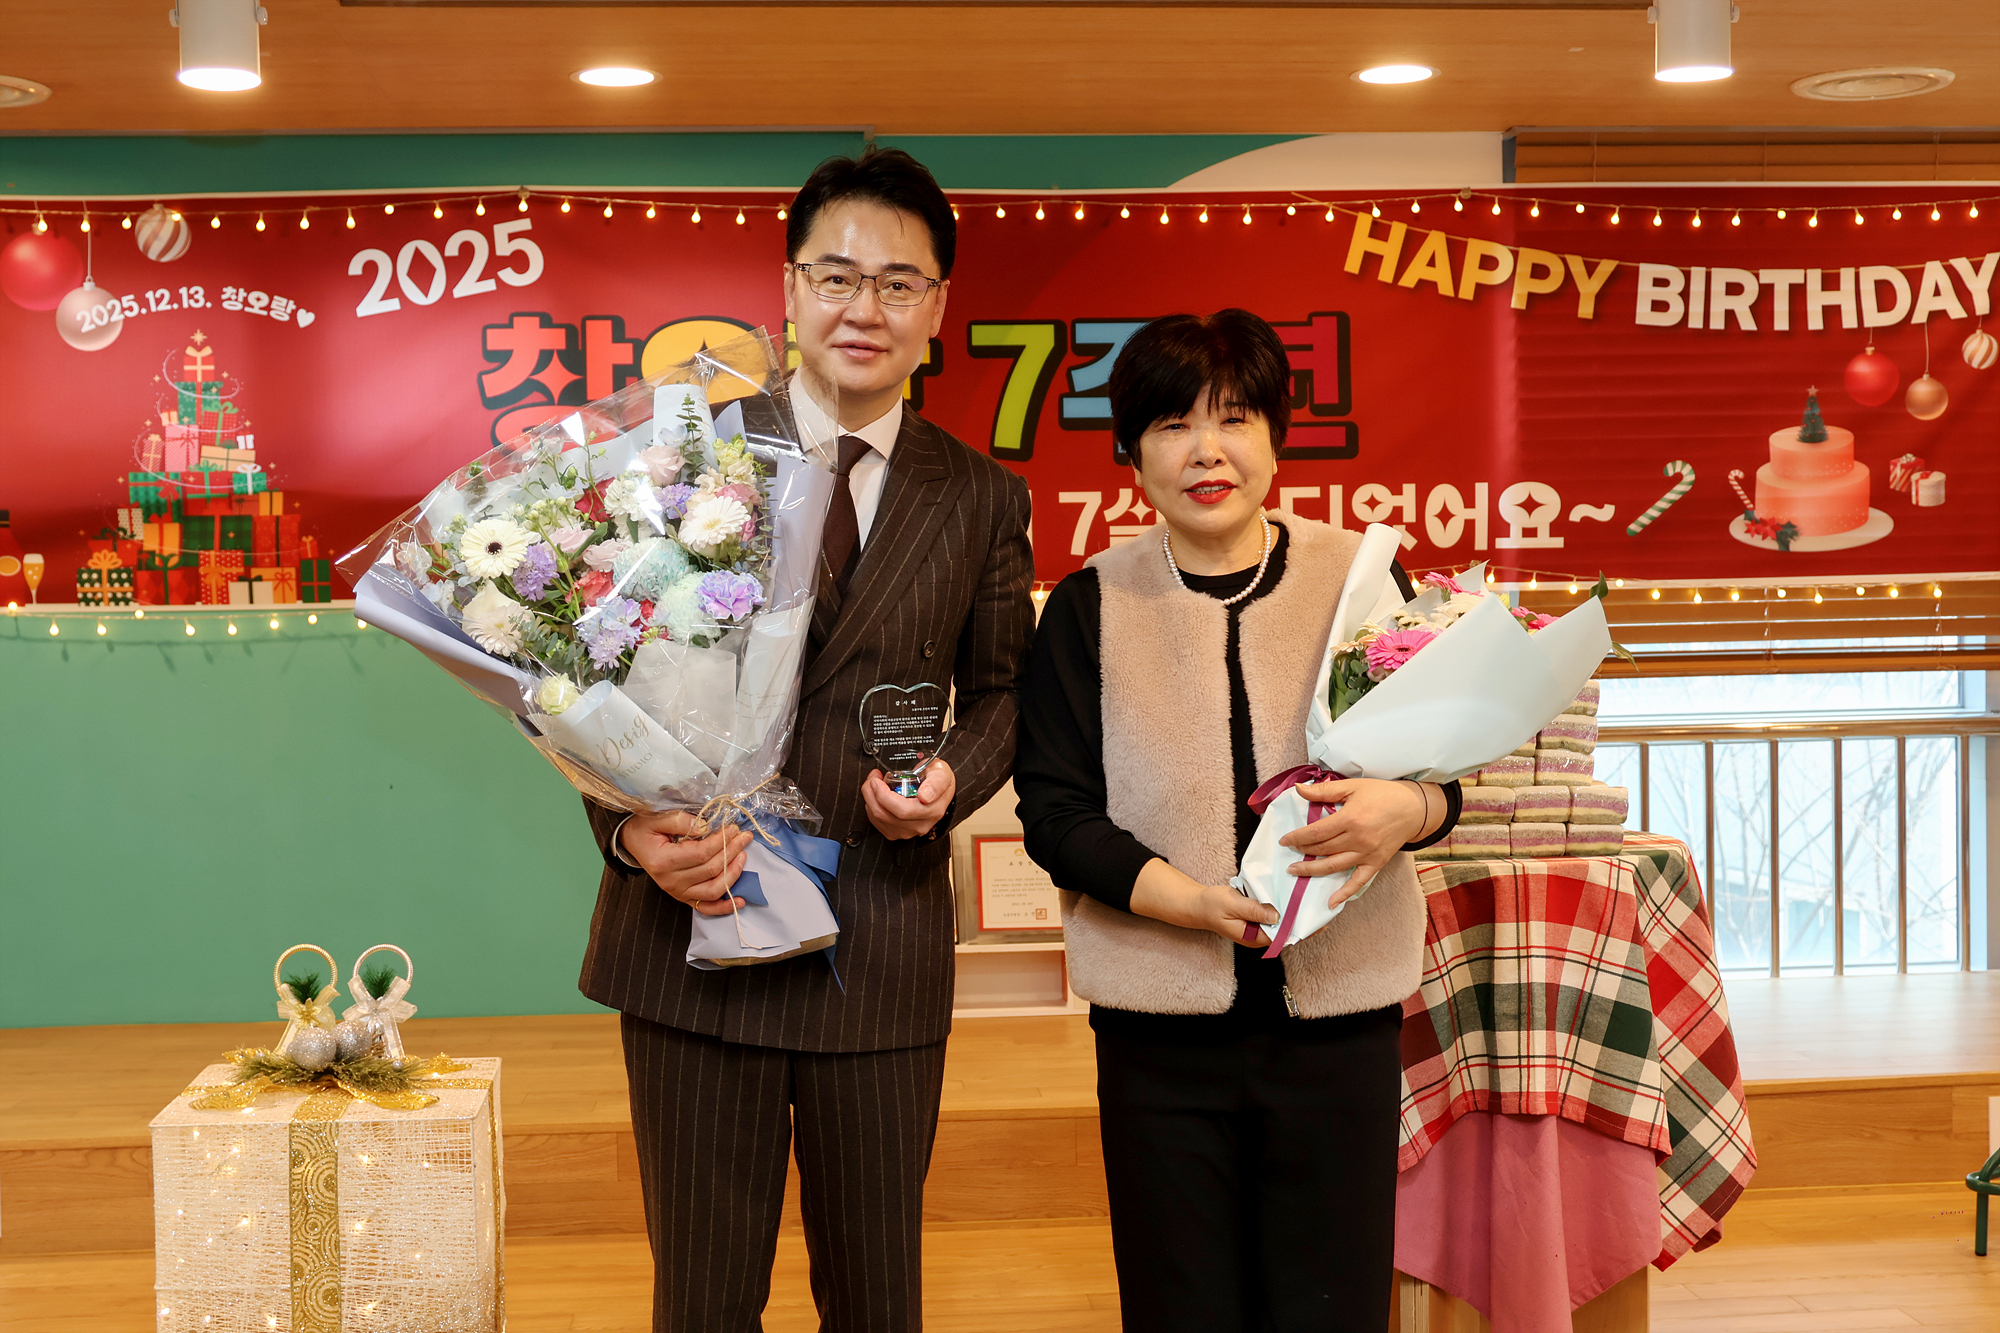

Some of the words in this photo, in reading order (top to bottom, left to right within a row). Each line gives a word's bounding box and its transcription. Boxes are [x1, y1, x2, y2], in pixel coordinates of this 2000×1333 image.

[76, 285, 213, 333] 2025.12.13.
[347, 217, 545, 318] 2025
[1343, 211, 1620, 320] HAPPY
[1634, 252, 2000, 331] BIRTHDAY
